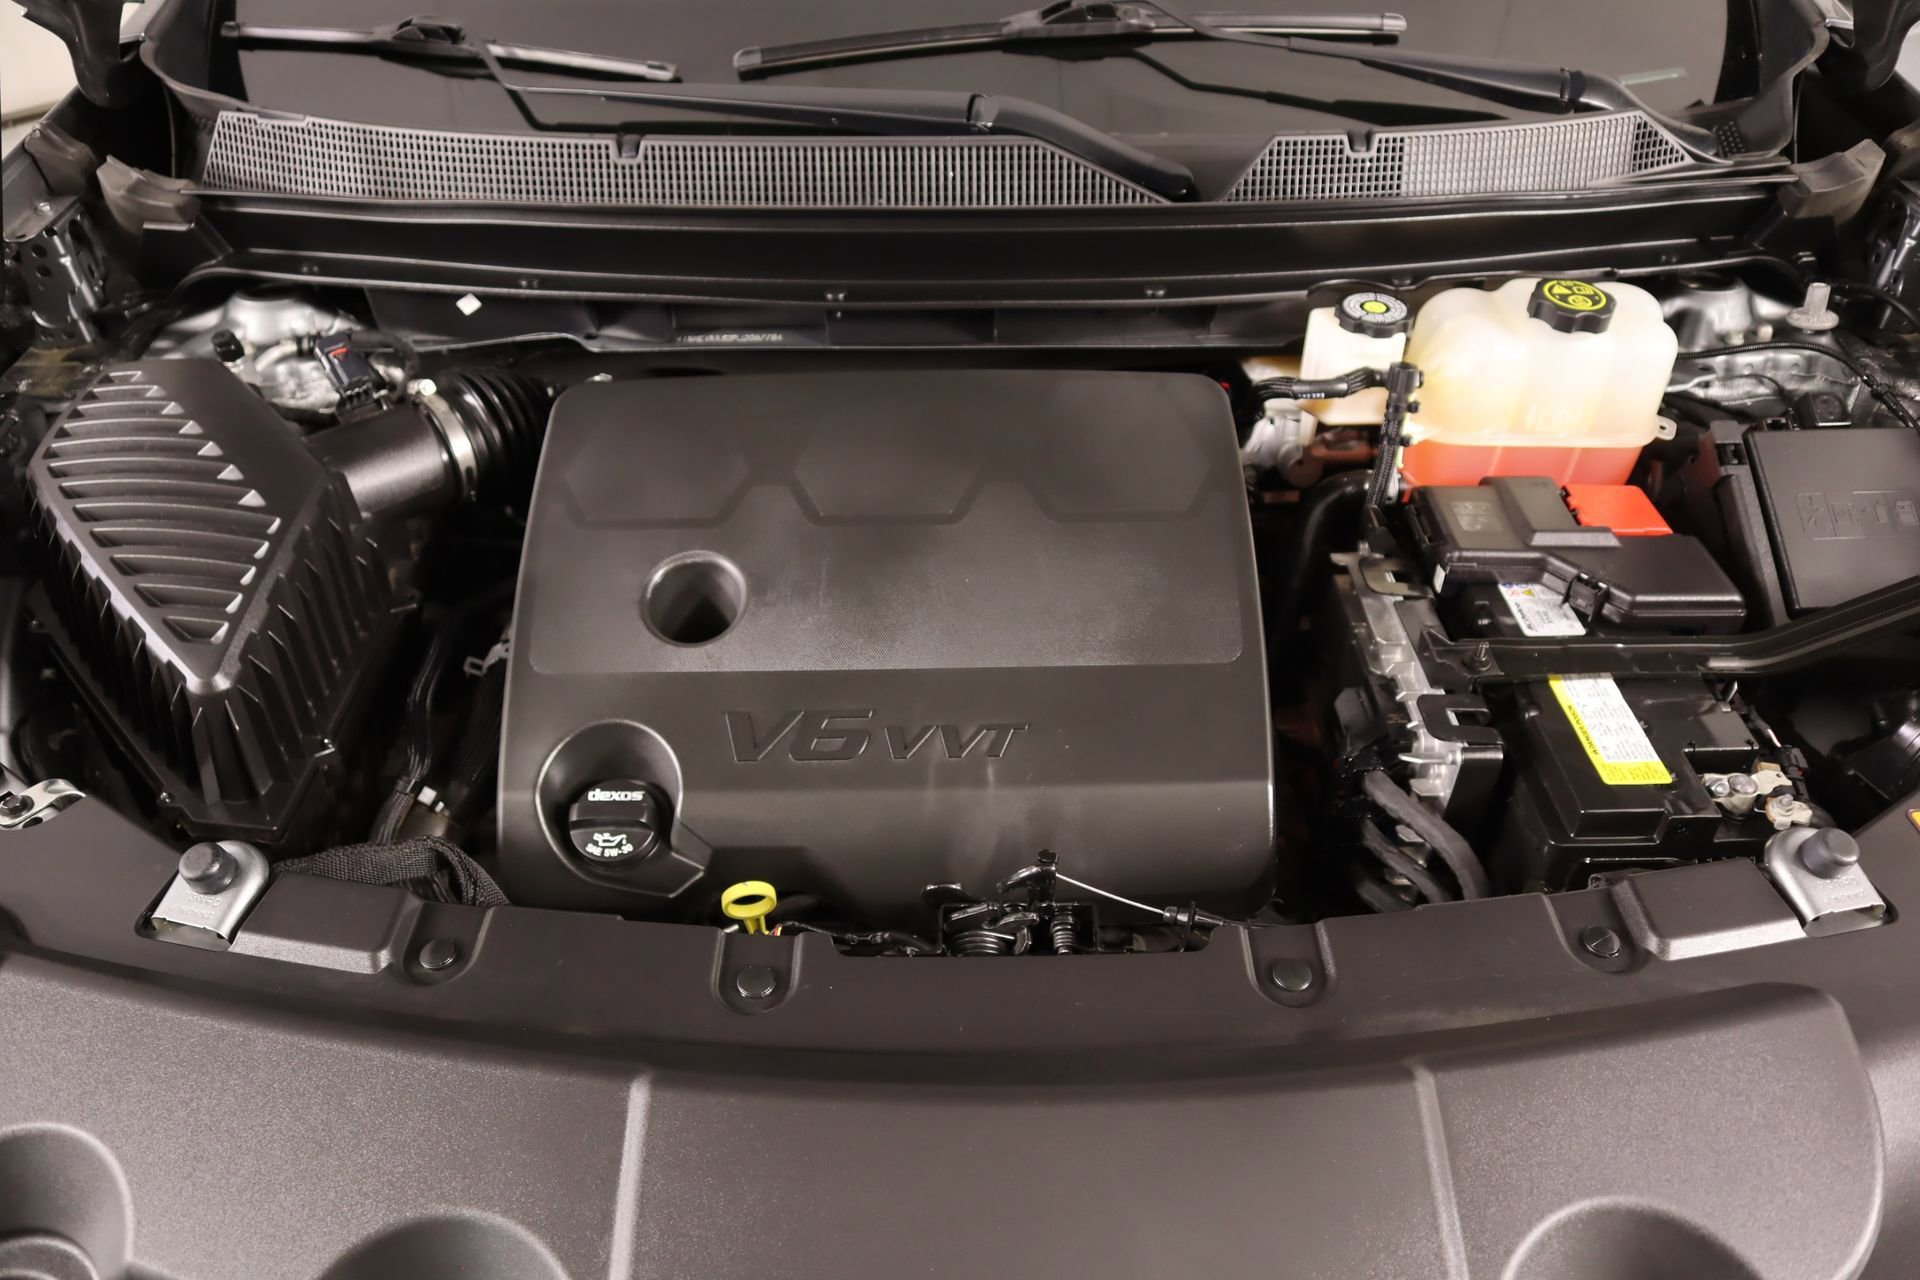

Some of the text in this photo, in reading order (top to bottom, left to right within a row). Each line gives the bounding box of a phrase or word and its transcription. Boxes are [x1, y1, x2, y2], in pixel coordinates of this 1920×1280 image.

[723, 709, 1031, 762] V6 VVT
[587, 788, 645, 801] dexos
[585, 843, 634, 857] SAE 5W-30
